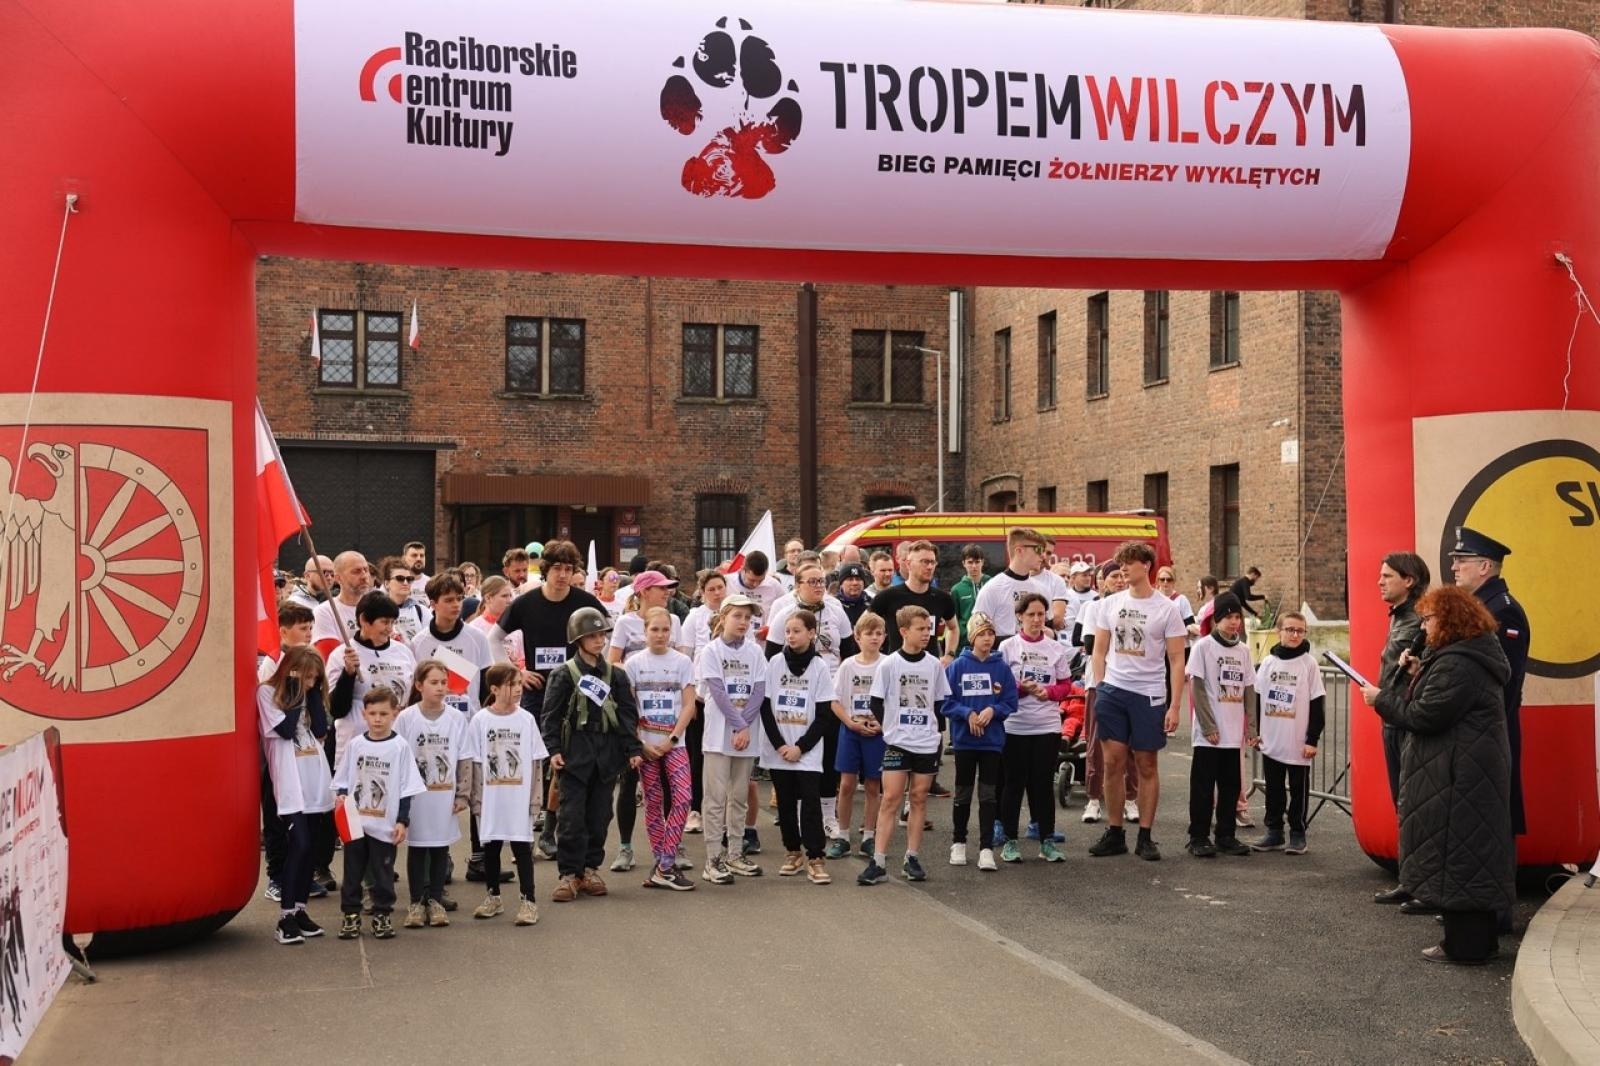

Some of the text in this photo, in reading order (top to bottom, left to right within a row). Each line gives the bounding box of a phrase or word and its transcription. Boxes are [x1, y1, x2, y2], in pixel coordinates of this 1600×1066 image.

[405, 31, 577, 79] Raciborskie
[406, 107, 514, 157] Kultury
[878, 153, 1321, 190] BIEG PAMIĘCI ŻOŁNIERZY WYKLĘTYCH
[543, 654, 560, 664] 127
[1228, 671, 1241, 680] 105
[735, 684, 747, 693] 69
[971, 681, 983, 689] 36
[652, 700, 664, 708] 51
[785, 696, 798, 705] 89
[907, 715, 924, 724] 129
